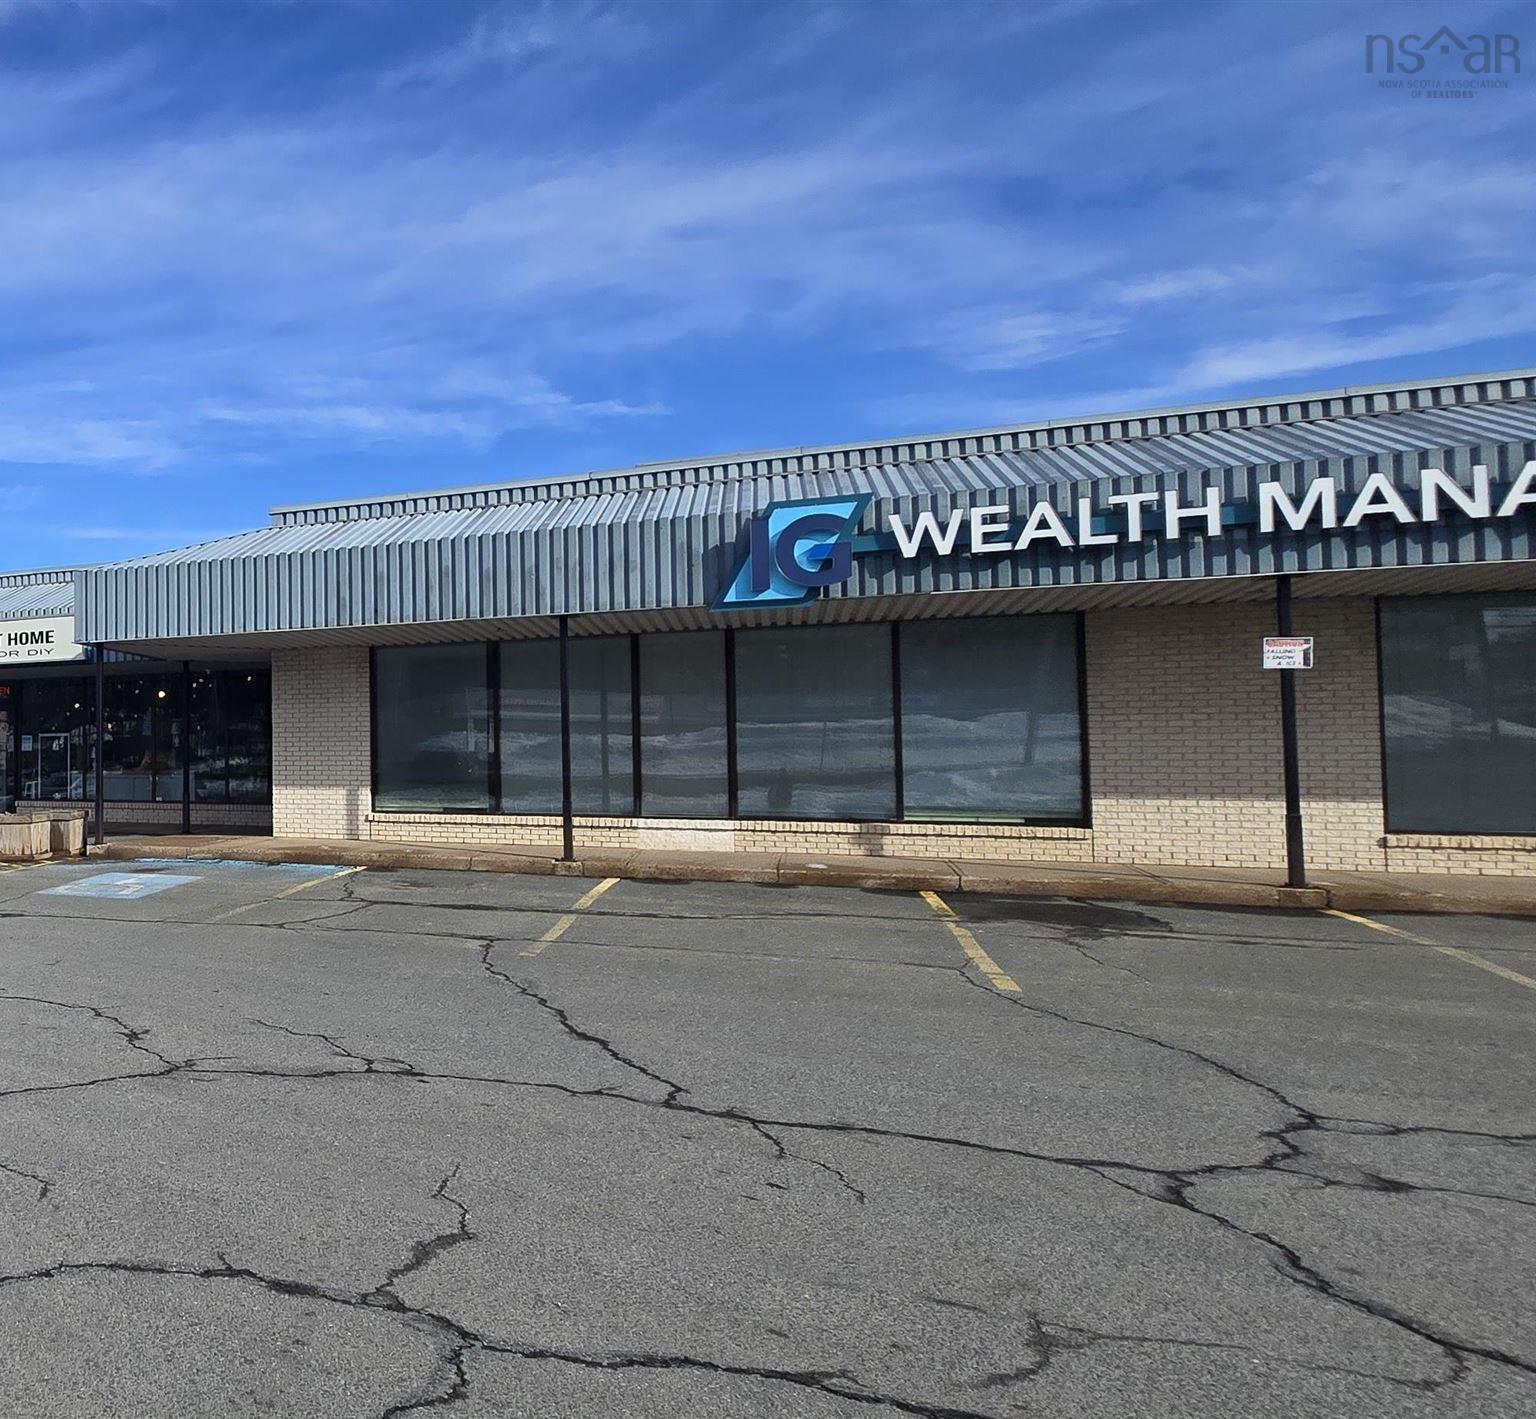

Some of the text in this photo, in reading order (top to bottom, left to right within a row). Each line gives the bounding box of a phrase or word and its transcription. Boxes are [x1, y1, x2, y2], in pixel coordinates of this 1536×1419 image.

[887, 486, 1221, 559] WEALTH
[750, 512, 853, 594] IG
[7, 629, 56, 647] HOME
[27, 647, 55, 657] DIY
